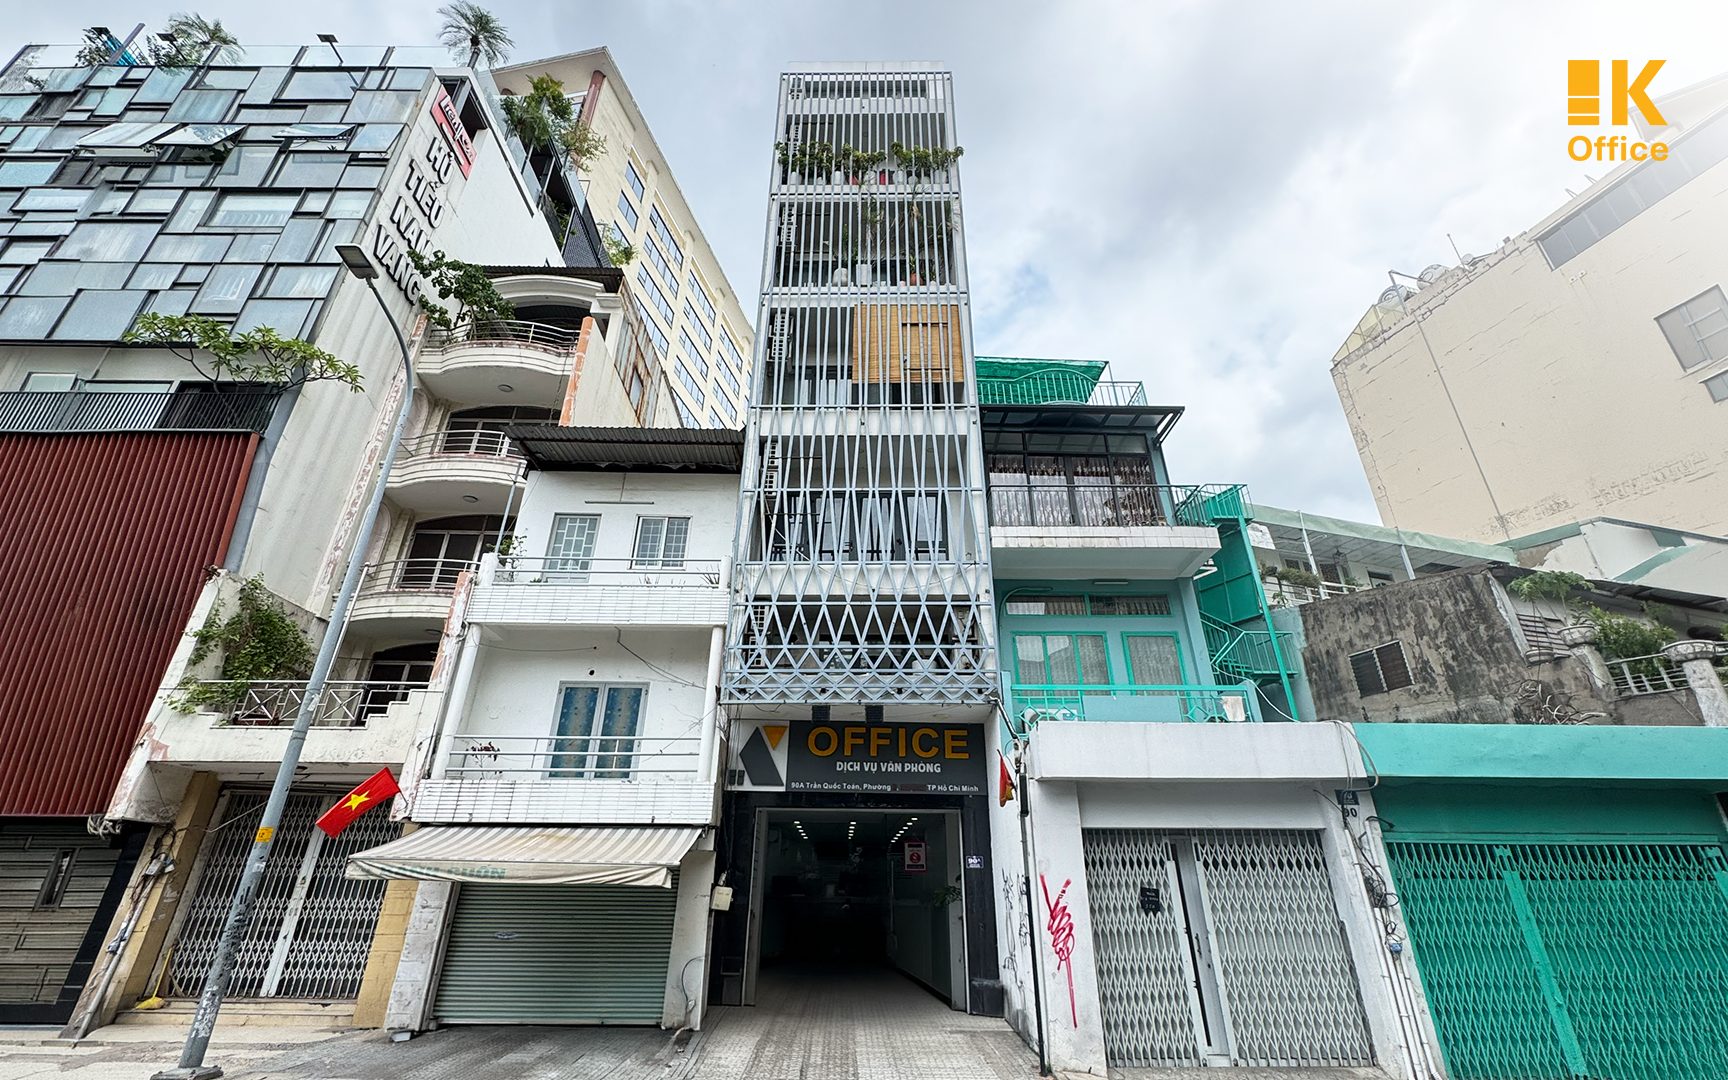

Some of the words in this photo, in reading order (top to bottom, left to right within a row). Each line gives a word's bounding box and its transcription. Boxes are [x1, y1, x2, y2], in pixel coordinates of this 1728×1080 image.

[390, 196, 435, 260] NAM
[373, 224, 422, 306] VANG
[807, 726, 970, 759] OFFICE
[836, 761, 860, 774] DỊCH
[863, 762, 878, 774] VỤ
[904, 760, 941, 774] PHÒNG
[791, 782, 805, 790] 90A
[927, 784, 936, 792] TP
[961, 784, 979, 792] Minh
